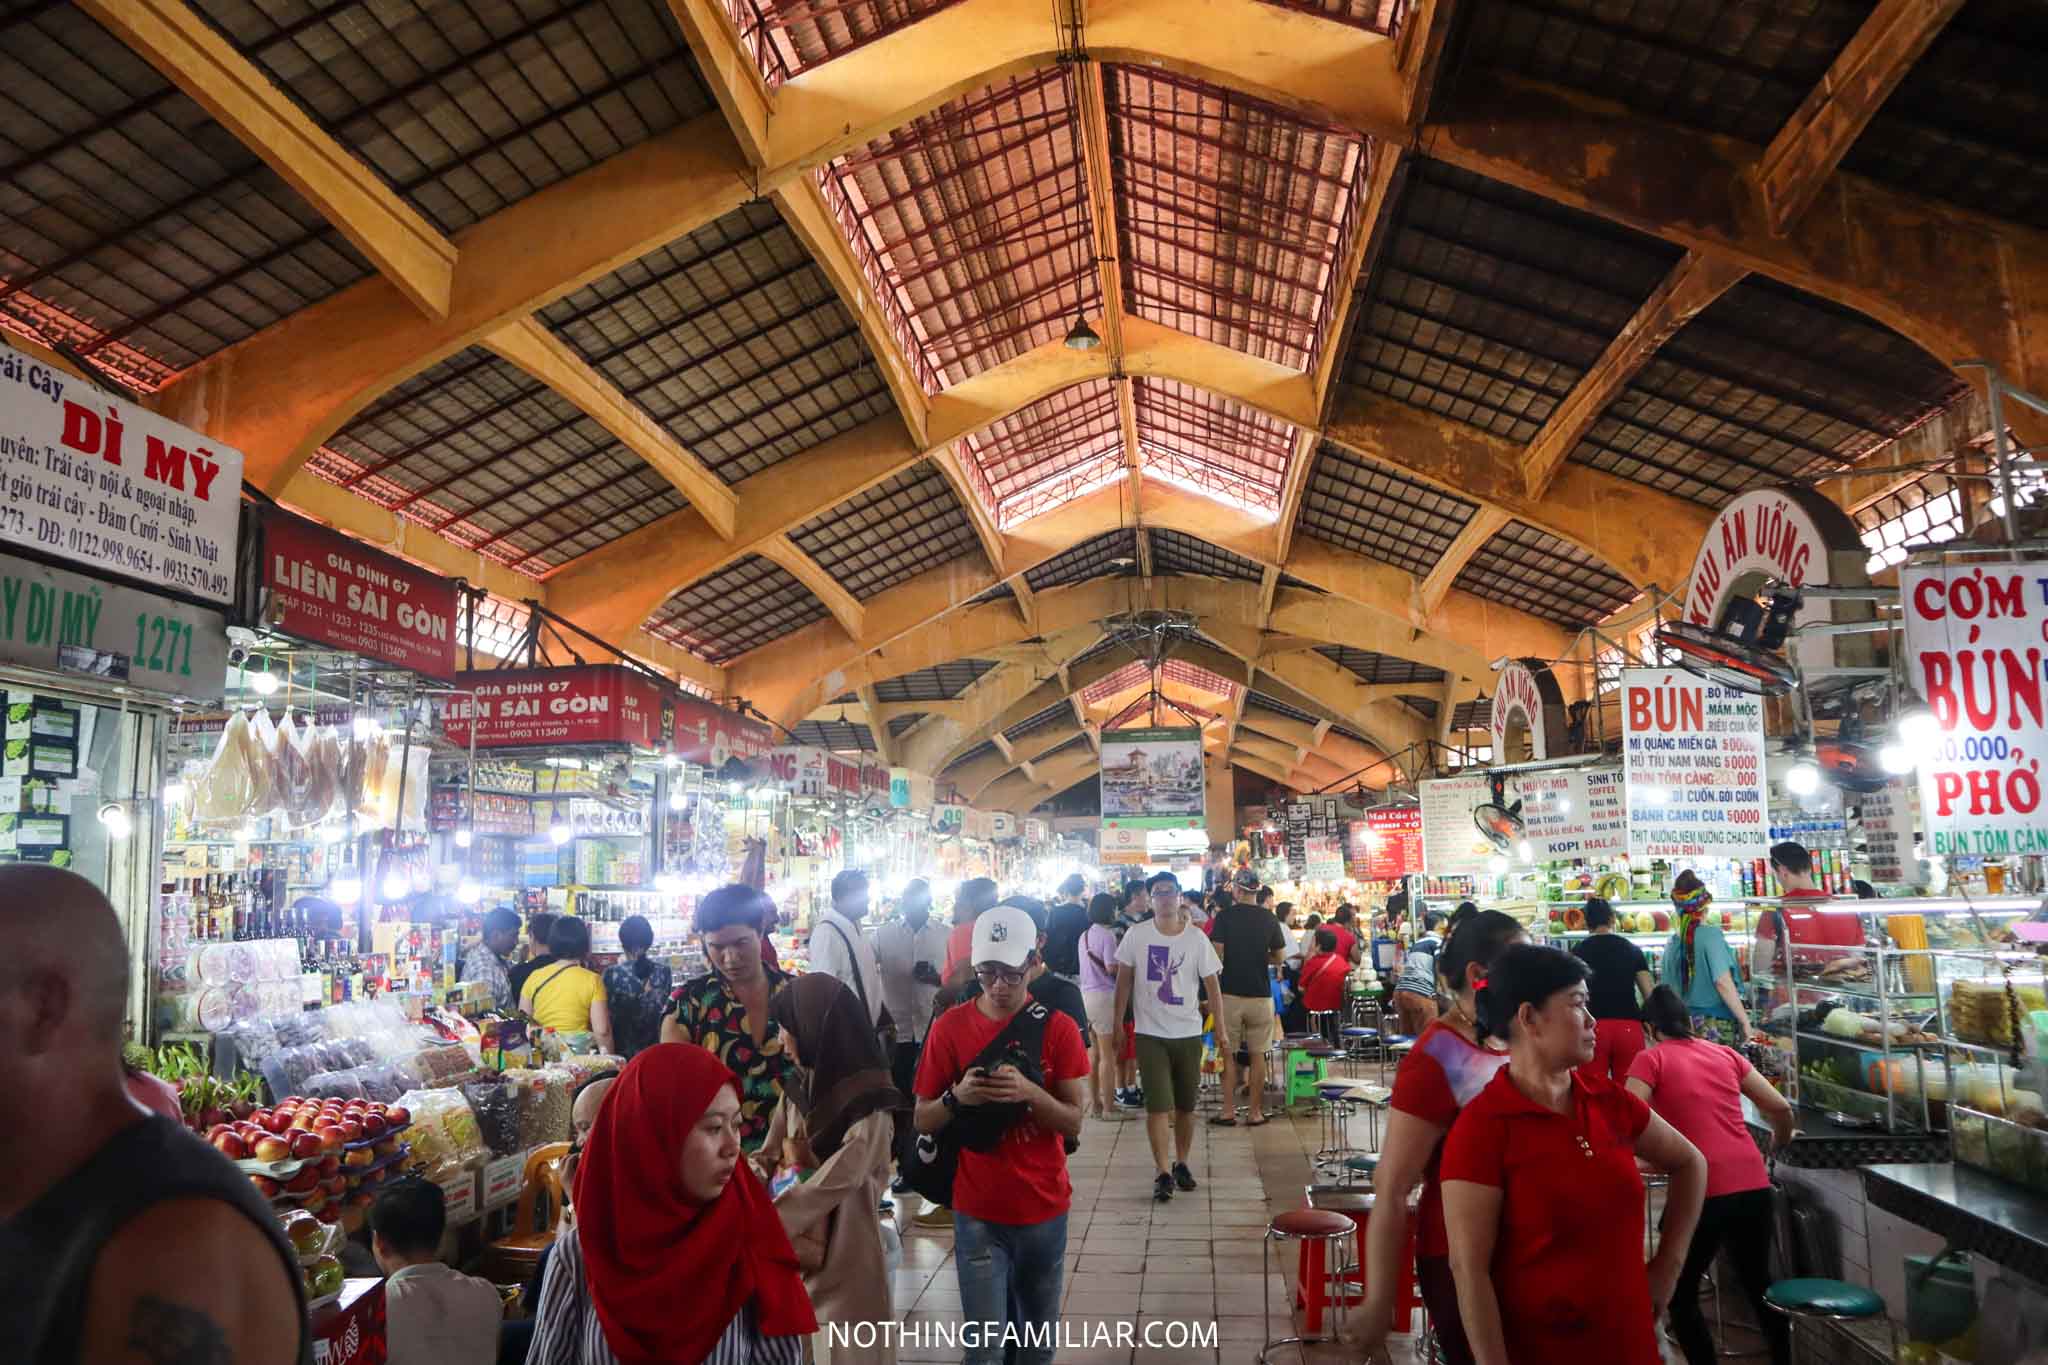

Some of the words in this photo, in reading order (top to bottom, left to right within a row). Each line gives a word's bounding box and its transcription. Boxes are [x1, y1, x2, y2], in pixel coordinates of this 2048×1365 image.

[29, 365, 64, 402] Cây
[60, 398, 124, 466] DÌ
[144, 435, 220, 501] MỸ
[45, 446, 72, 477] Trái
[75, 460, 96, 492] cây
[100, 470, 119, 499] nội
[122, 477, 132, 499] &
[136, 487, 166, 516] ngoại
[36, 483, 62, 509] trái
[64, 491, 87, 523] cây
[168, 526, 191, 554] Sinh
[327, 552, 353, 574] GIA
[392, 578, 410, 596] G7
[1690, 547, 1720, 625] KHU
[1720, 509, 1748, 571] ĂN
[1756, 501, 1810, 588] UỐNG
[274, 554, 337, 603] LIÊN
[347, 583, 388, 622] SÀI
[396, 602, 448, 641] GÒN
[1913, 567, 2027, 621] CƠM
[133, 611, 193, 677] 1271
[475, 684, 500, 696] GIA
[1628, 675, 1704, 732] BÚN
[1919, 624, 2043, 731] BÚN
[438, 698, 490, 720] LIÊN
[501, 696, 540, 717] SÀI
[550, 693, 609, 714] GÒN
[1587, 774, 1608, 785] SINH
[1724, 755, 1757, 769] 50000
[1933, 747, 2042, 816] PHỞ
[1728, 809, 1759, 823] 50000
[1972, 823, 2008, 853] TÔM
[1548, 841, 1579, 853] KOPI
